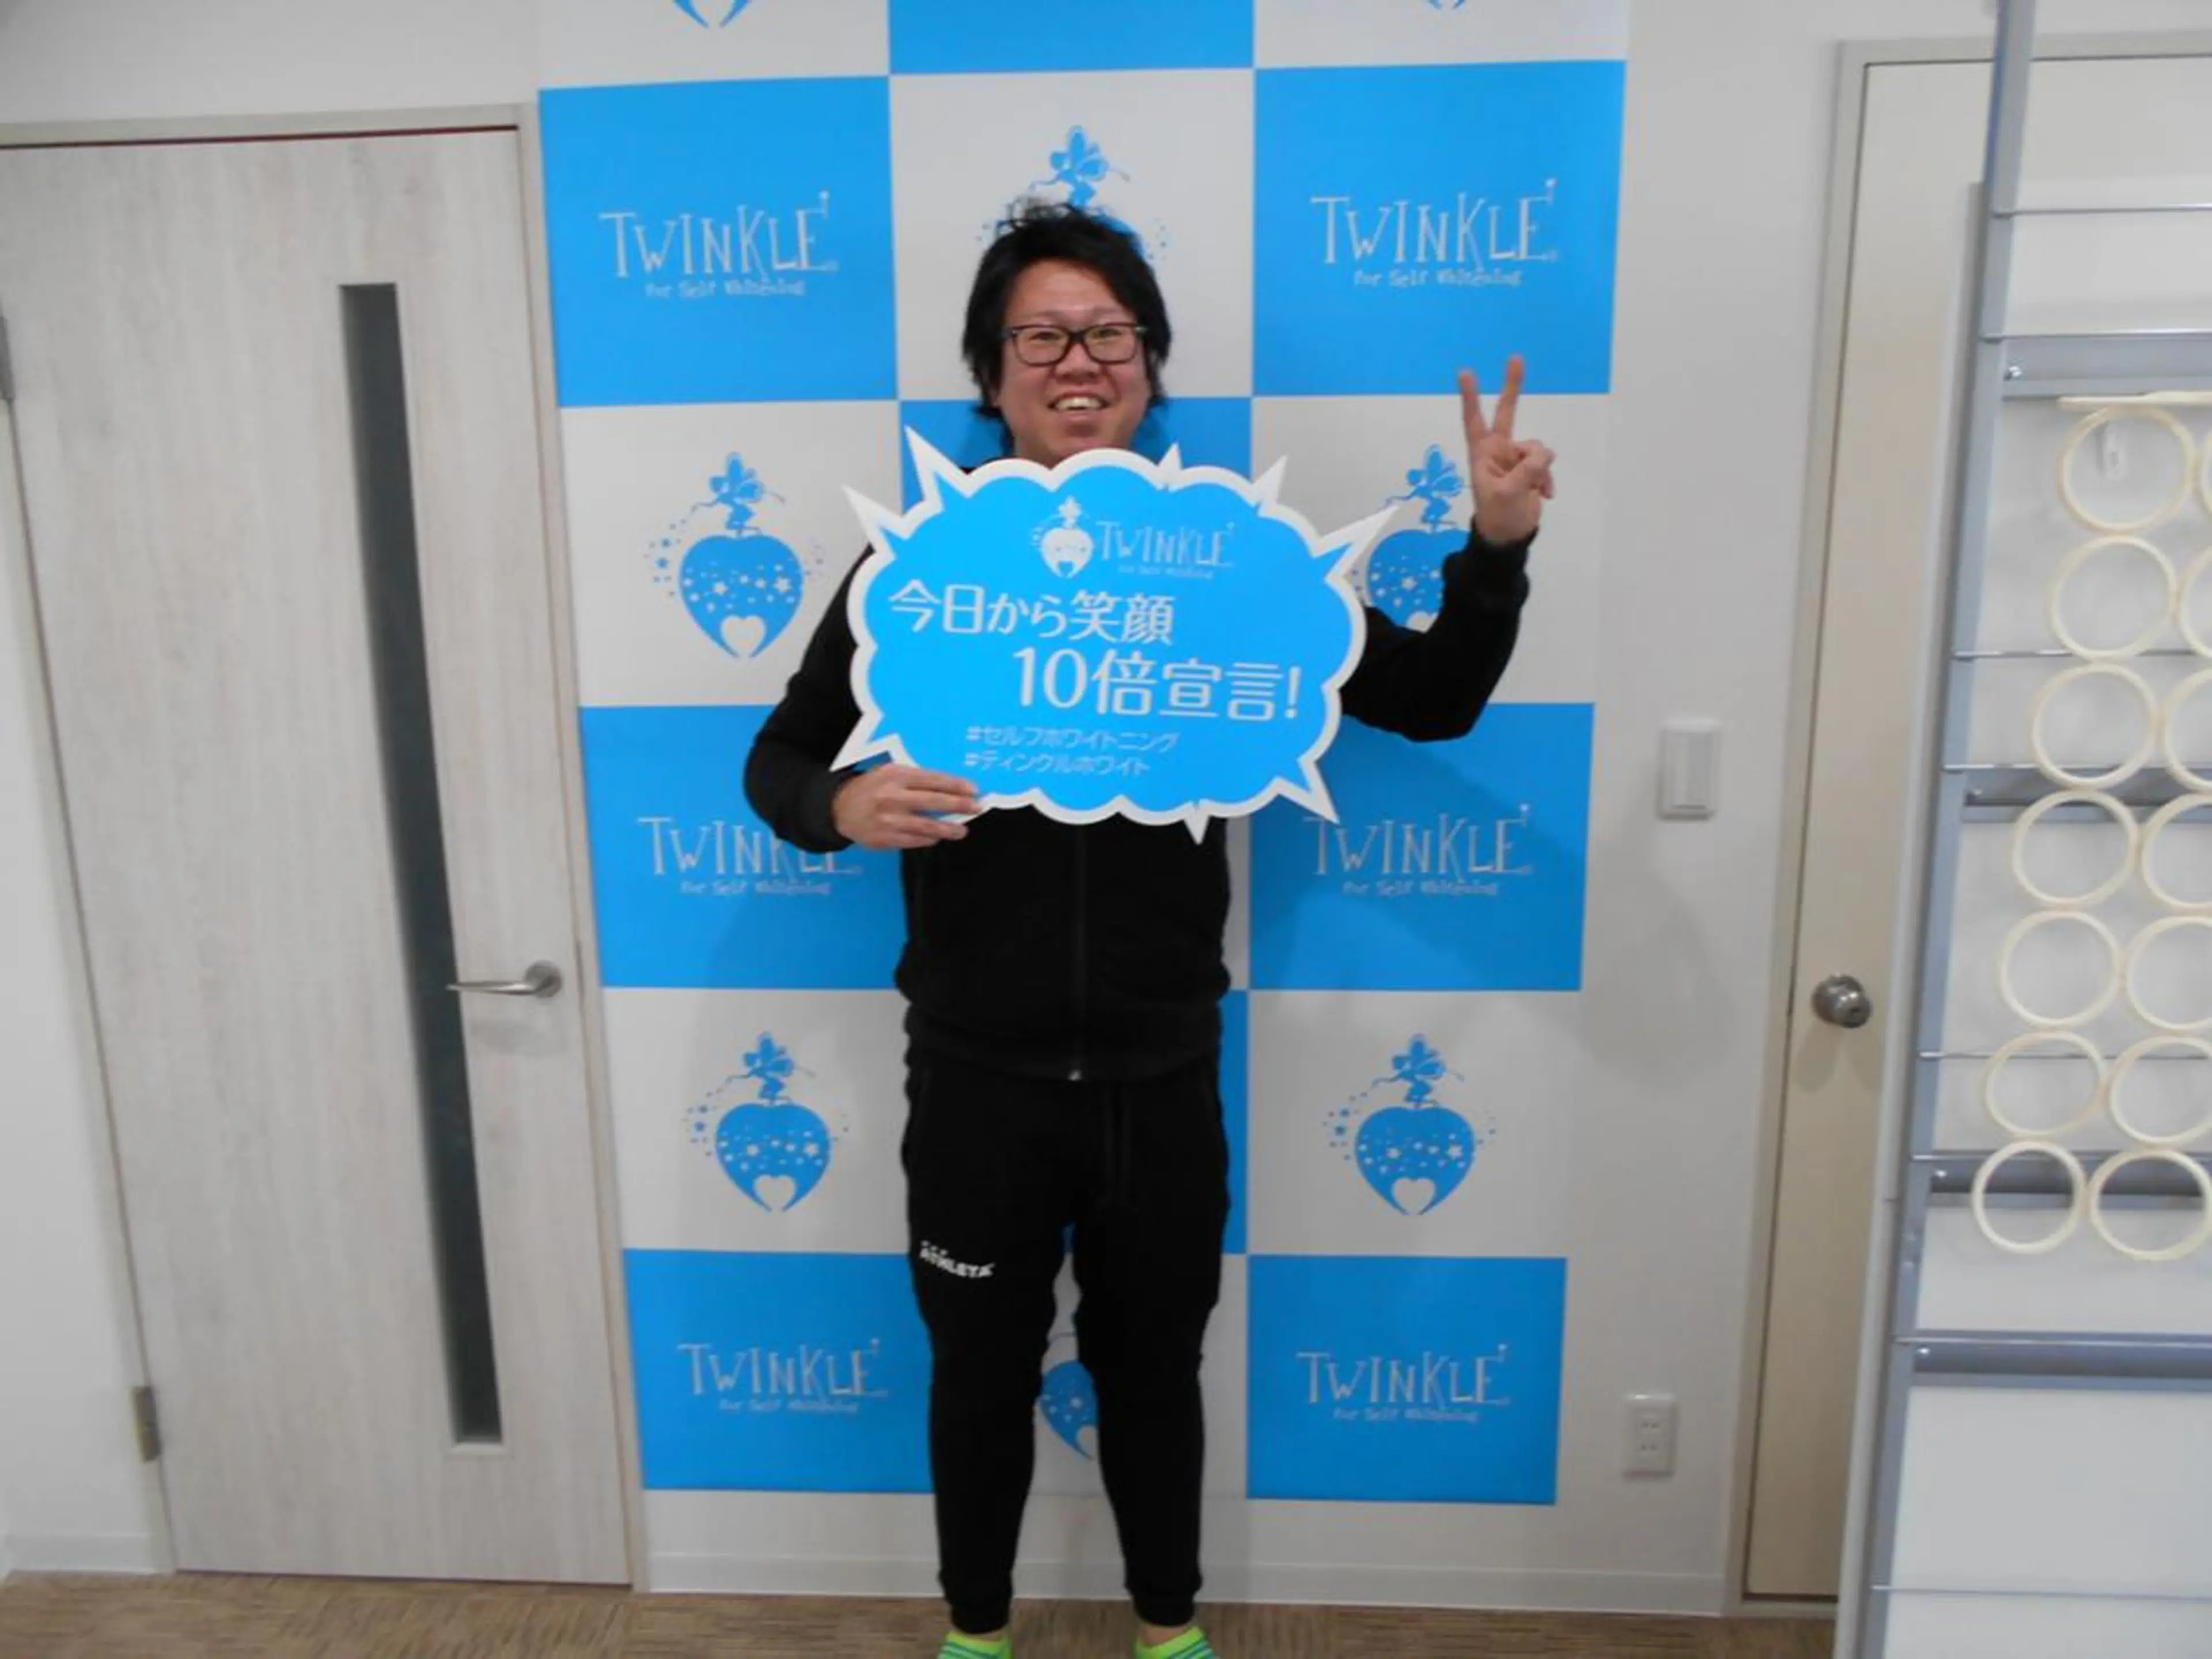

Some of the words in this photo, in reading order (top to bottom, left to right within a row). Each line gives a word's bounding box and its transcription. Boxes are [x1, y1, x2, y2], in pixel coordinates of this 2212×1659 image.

[598, 190, 838, 280] TWINKLE
[1310, 177, 1558, 271] TWINKLE
[888, 579, 1175, 646] 今日から笑顔
[1012, 647, 1302, 722] 10倍宣言!
